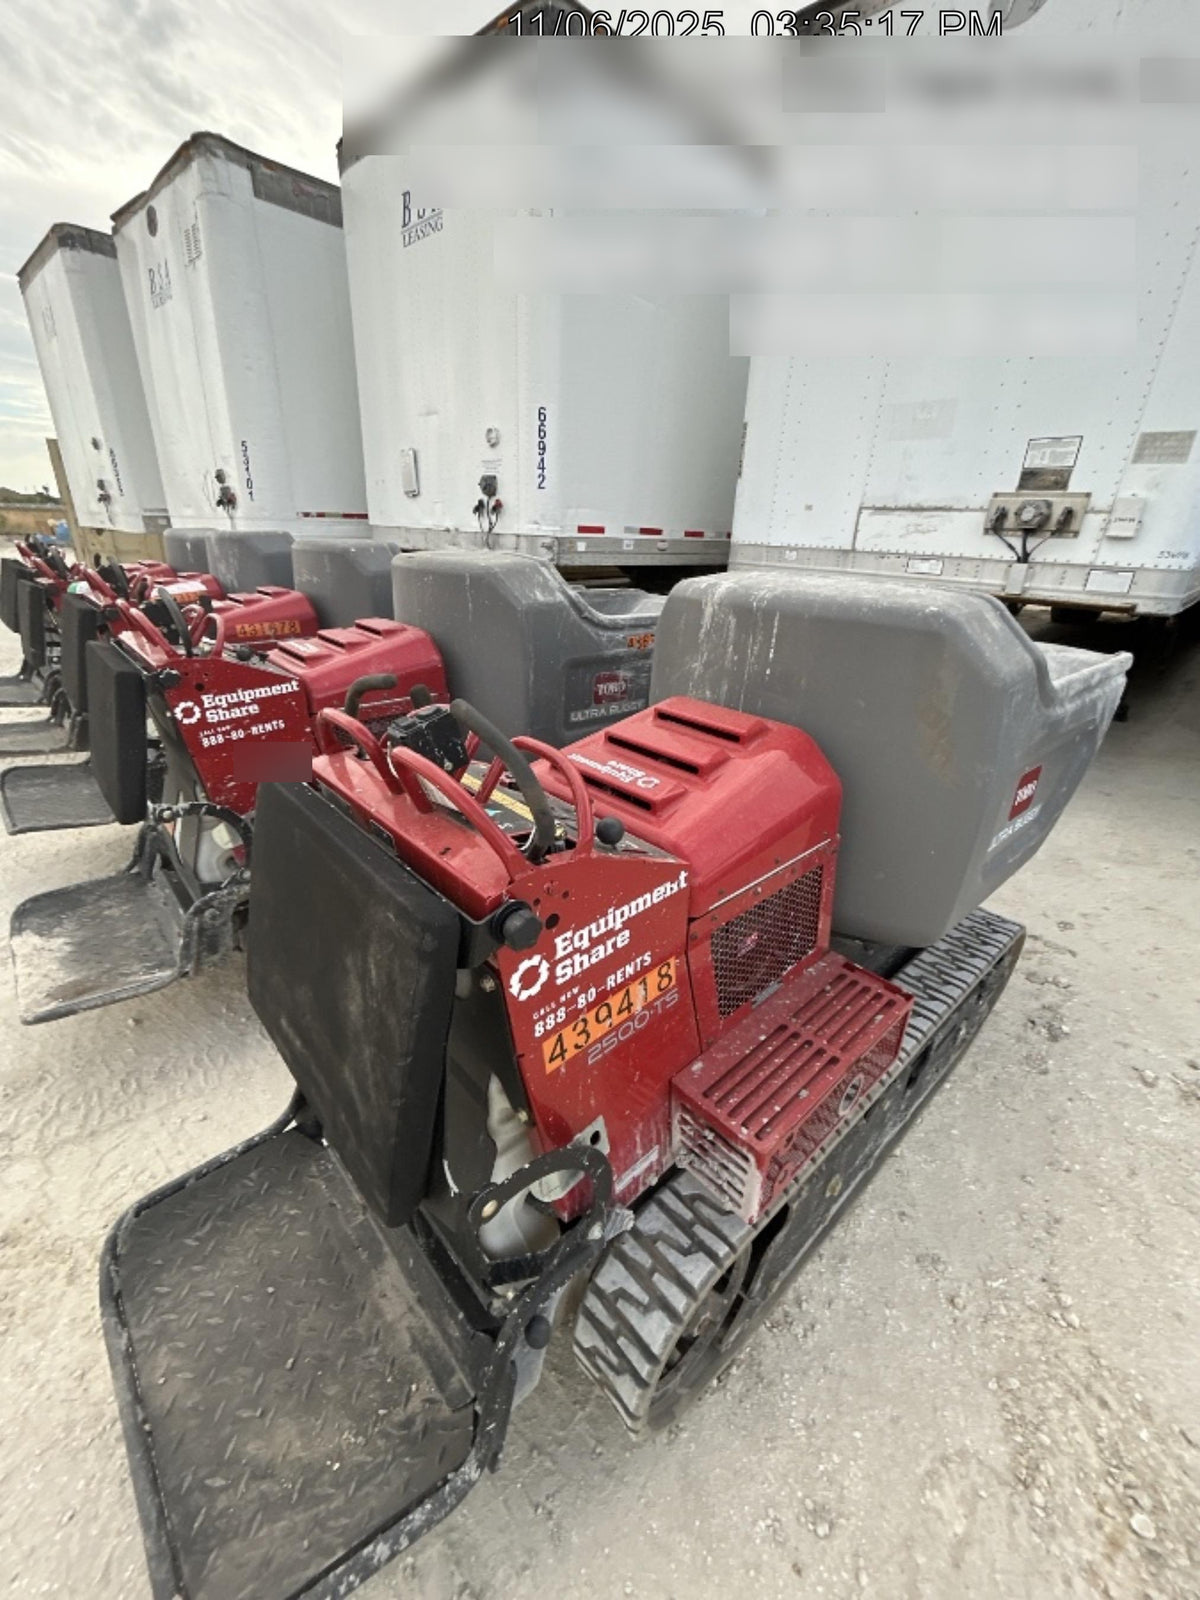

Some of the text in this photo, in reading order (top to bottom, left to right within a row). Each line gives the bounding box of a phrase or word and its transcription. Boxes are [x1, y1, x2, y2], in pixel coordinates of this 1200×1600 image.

[401, 216, 443, 248] LEASING
[537, 406, 547, 490] 66942
[201, 679, 300, 708] Equipment
[205, 703, 260, 723] Share
[570, 707, 607, 722] ULTRA
[201, 719, 286, 748] 888-80-RENTS
[554, 869, 689, 960] Equipment
[555, 929, 631, 985] Share
[534, 950, 652, 1038] 888-80-RENTS
[548, 961, 673, 1065] 439418
